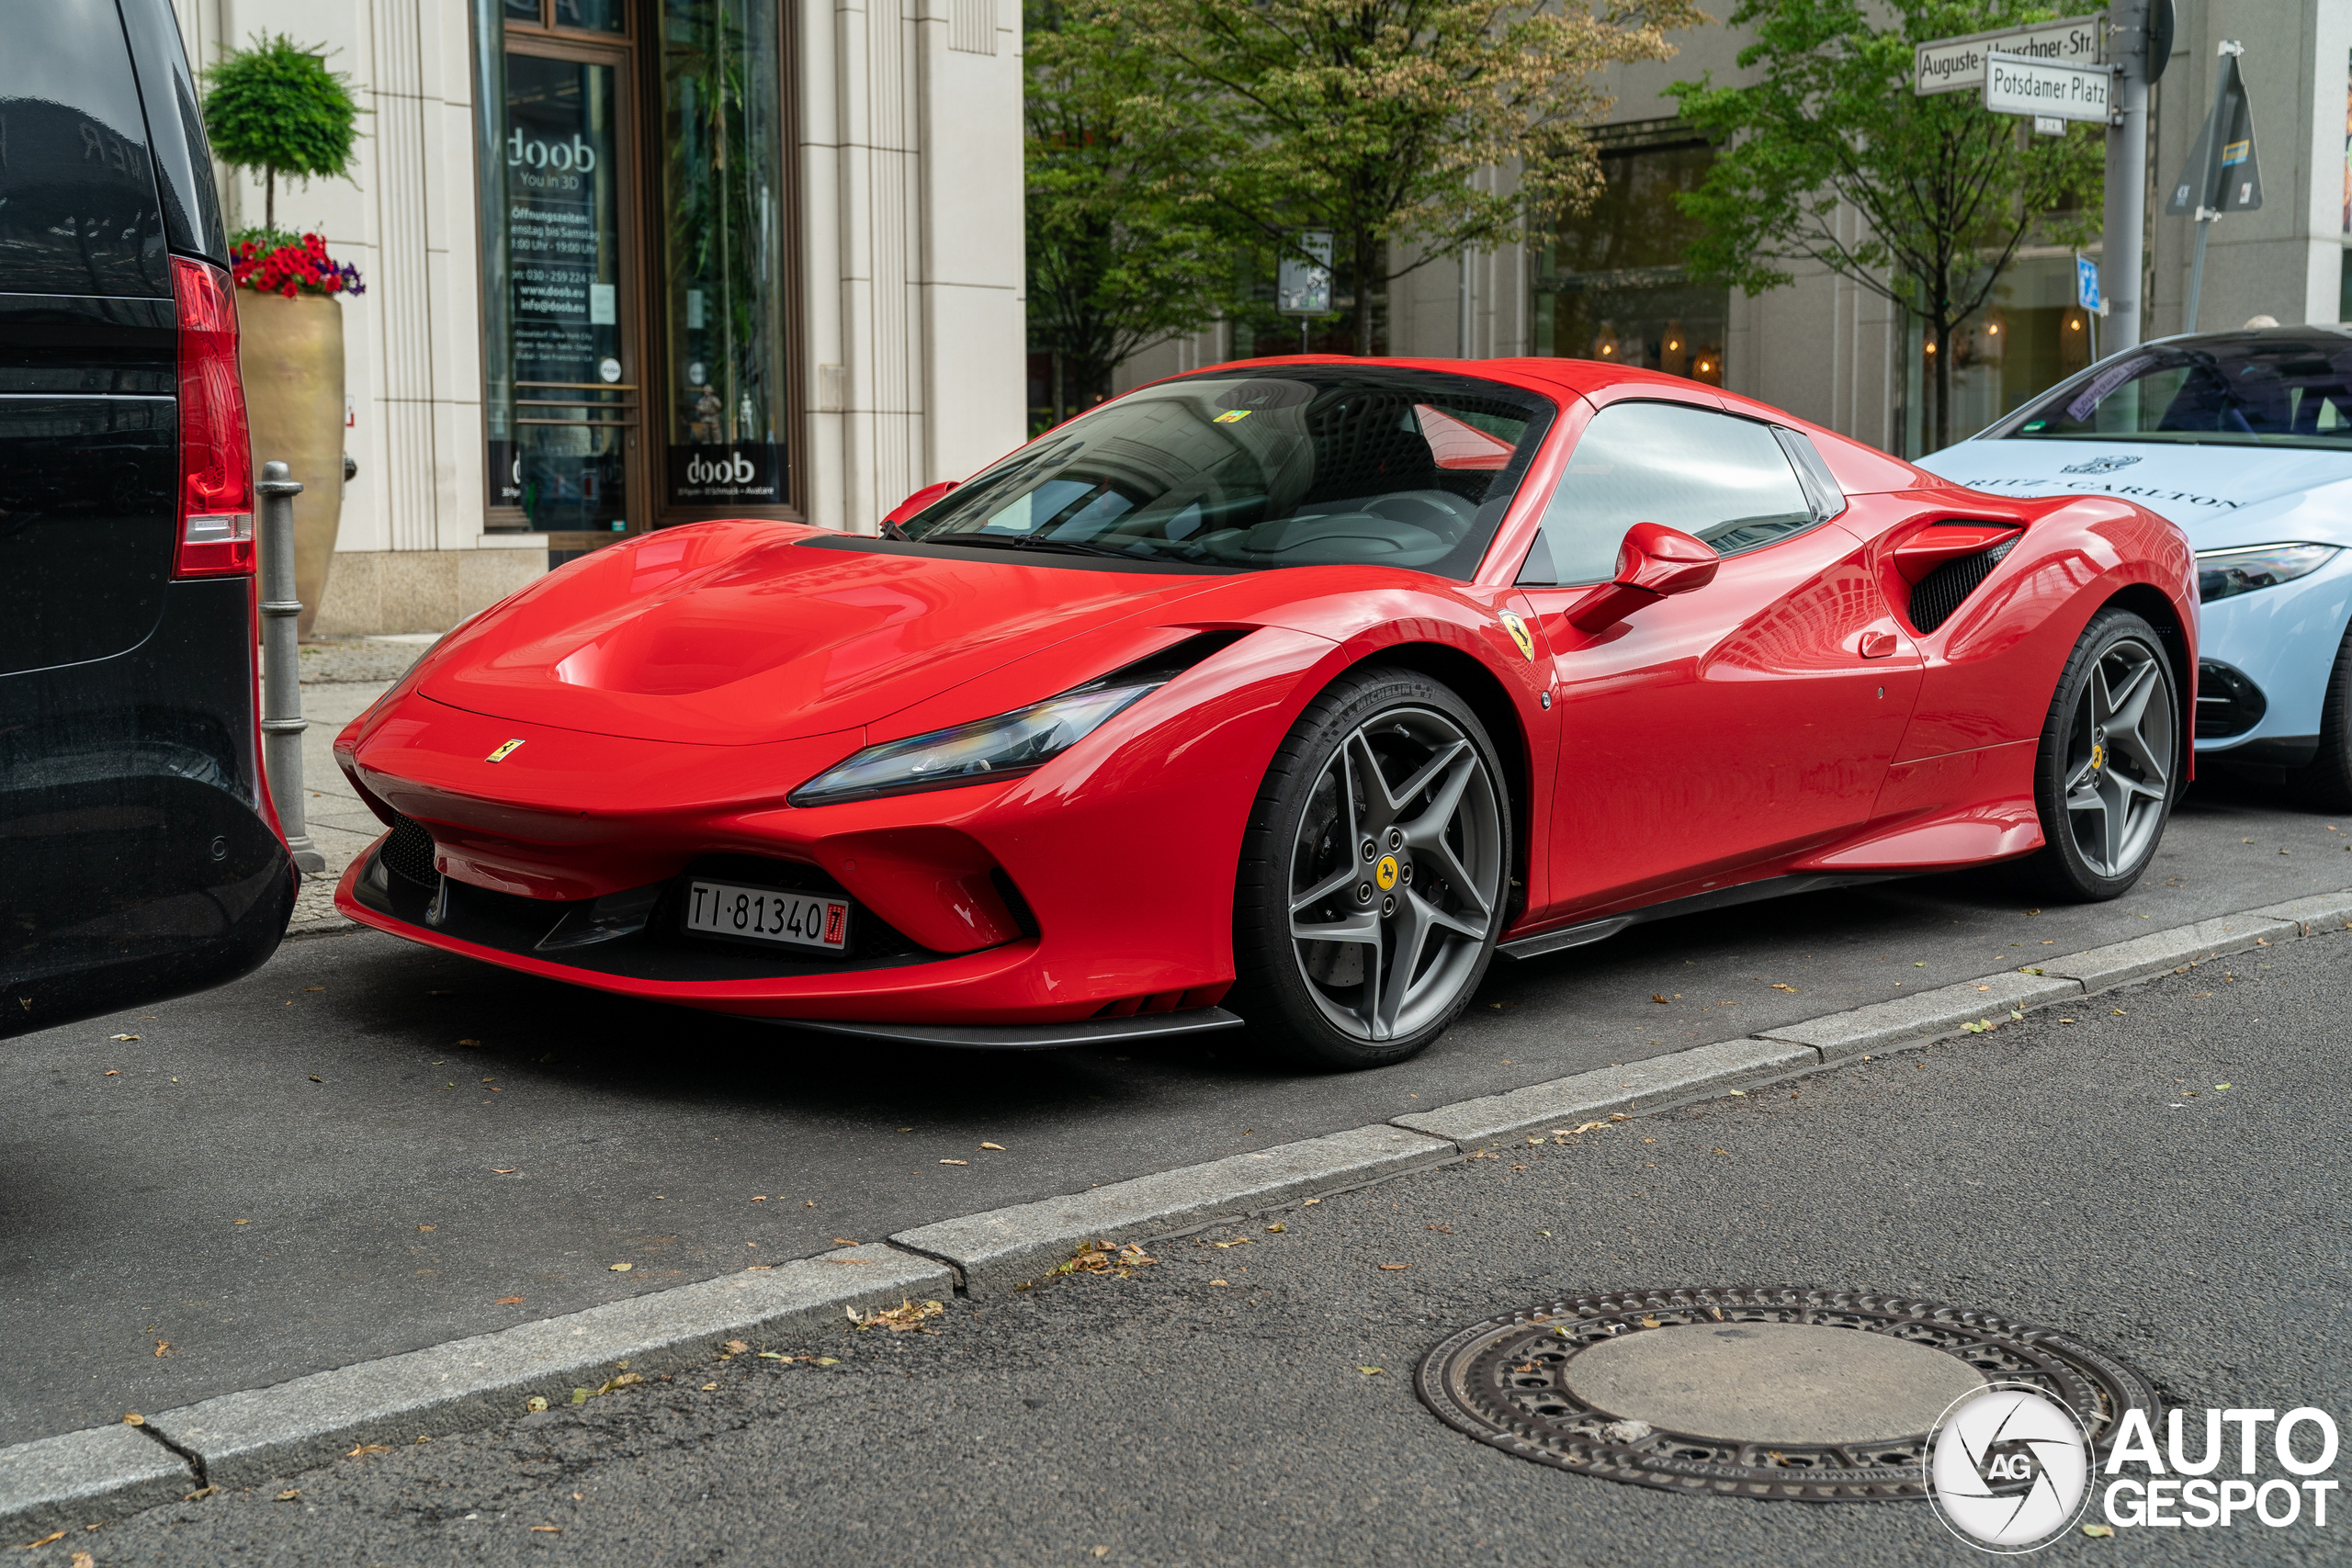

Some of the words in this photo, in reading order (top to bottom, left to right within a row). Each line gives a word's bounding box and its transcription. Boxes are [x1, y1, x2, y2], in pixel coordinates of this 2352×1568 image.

[1921, 30, 2094, 80] Auguste-schner-Str.
[1995, 68, 2066, 99] Potsdamer
[2071, 76, 2105, 104] Platz
[507, 127, 595, 174] doob
[519, 171, 544, 187] You
[546, 175, 559, 188] in
[561, 175, 580, 190] 3D
[531, 239, 548, 252] Uhr
[545, 224, 560, 237] bis
[560, 226, 600, 243] Samstag
[520, 284, 585, 299] www.doob.eu
[520, 298, 586, 313] info@doob.eu
[686, 451, 755, 485] doob
[1356, 682, 1411, 713] MICHELIN
